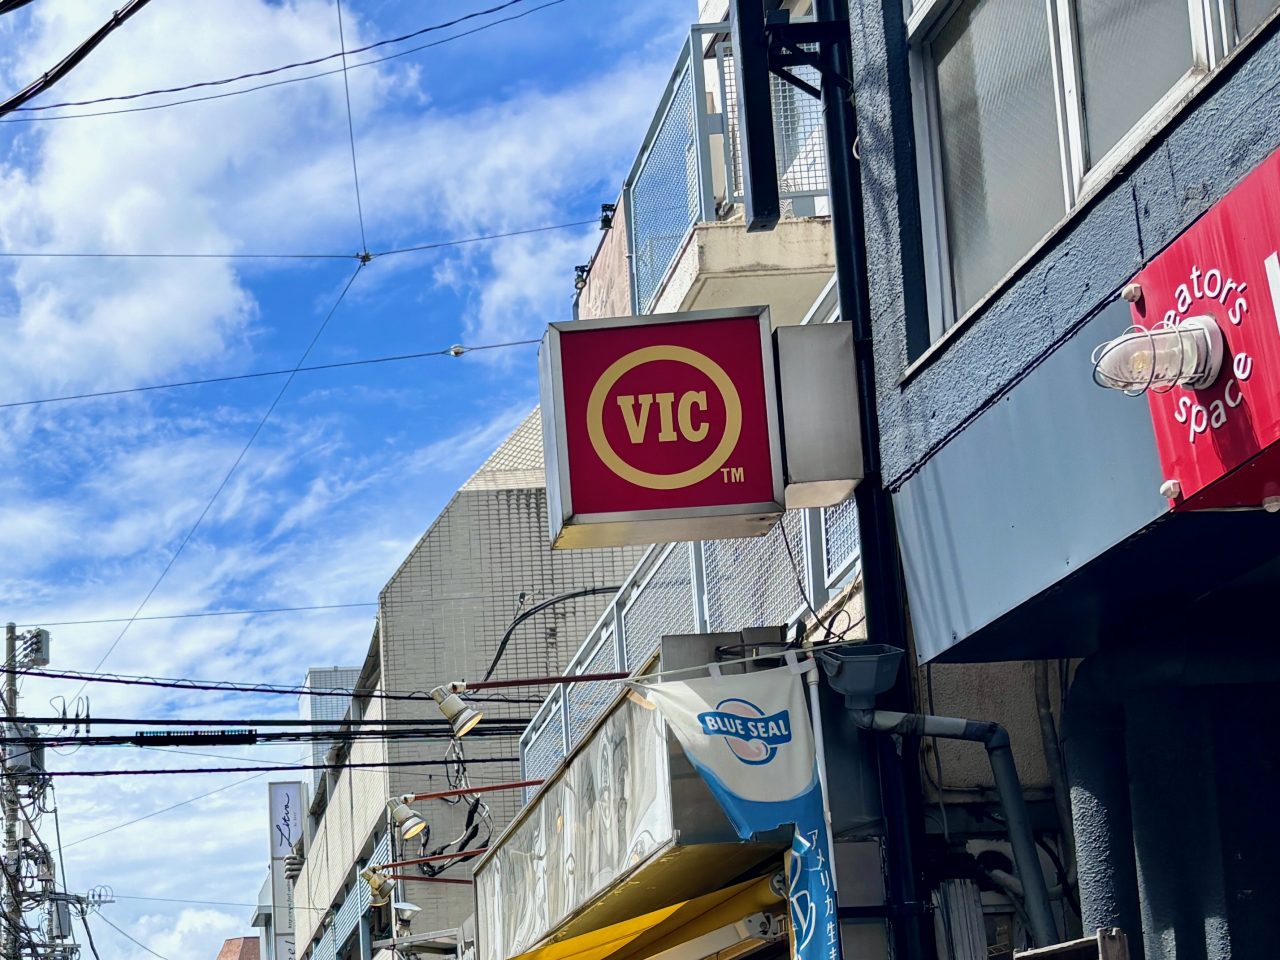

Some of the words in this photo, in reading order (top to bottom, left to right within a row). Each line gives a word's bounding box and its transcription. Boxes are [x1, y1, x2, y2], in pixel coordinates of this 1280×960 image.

[1174, 352, 1252, 442] space
[617, 391, 709, 443] VIC
[721, 467, 744, 483] TM
[705, 716, 746, 734] BLUE
[747, 719, 788, 738] SEAL
